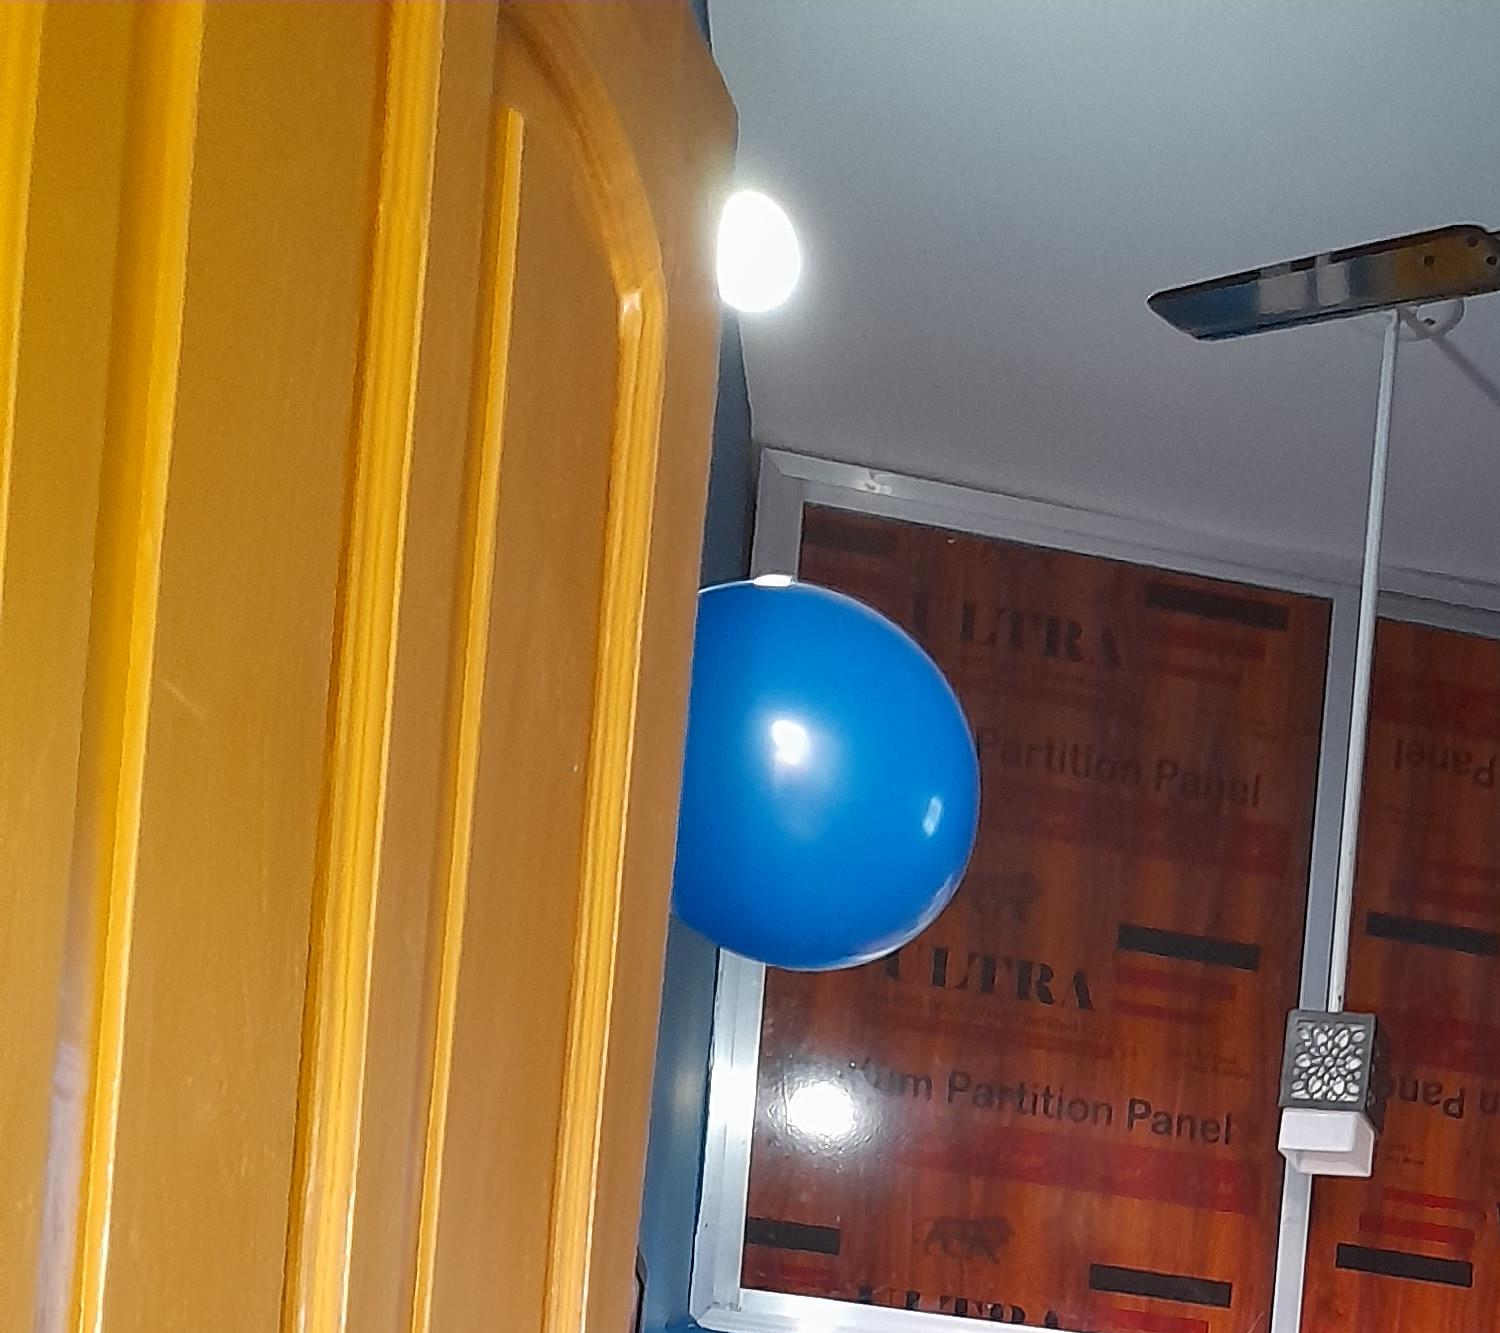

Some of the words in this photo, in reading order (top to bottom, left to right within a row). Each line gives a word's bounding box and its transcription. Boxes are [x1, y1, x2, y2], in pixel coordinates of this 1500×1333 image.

[978, 728, 1142, 790] Partition
[1153, 756, 1261, 808] Panel
[1393, 738, 1497, 790] Panel
[947, 1070, 1113, 1128] Partition
[1127, 1097, 1233, 1146] Panel
